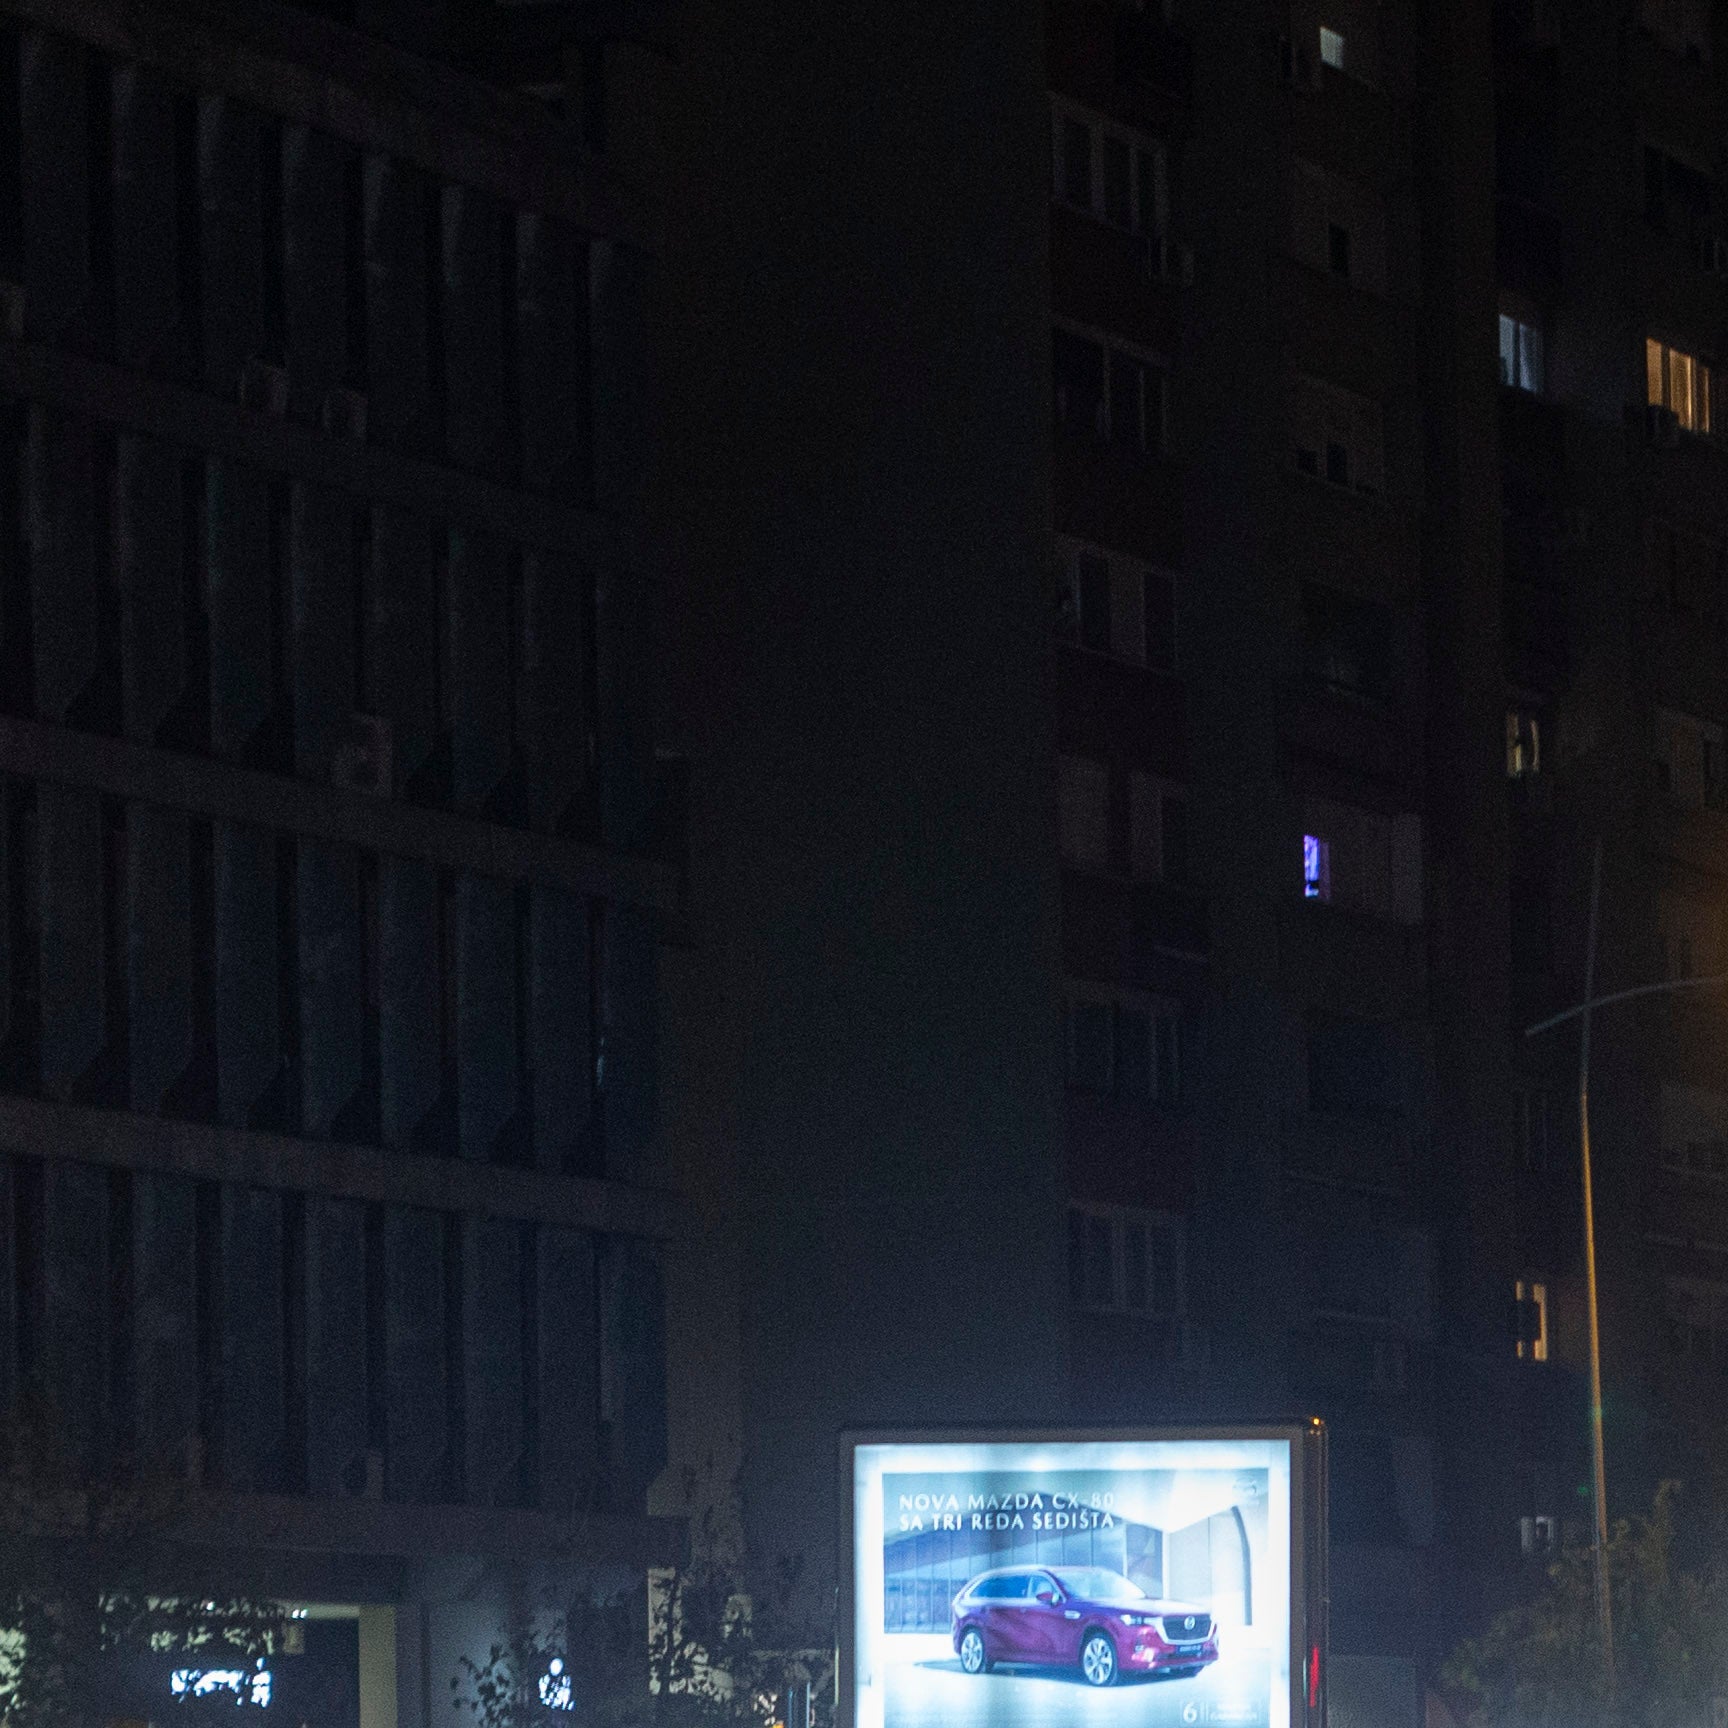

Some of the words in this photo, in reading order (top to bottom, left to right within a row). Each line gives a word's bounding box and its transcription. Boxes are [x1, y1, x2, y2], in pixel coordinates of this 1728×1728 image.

[900, 1493, 959, 1511] NOVA
[967, 1493, 1043, 1511] MAZDA
[1052, 1492, 1114, 1510] CX-80
[900, 1513, 923, 1531] SA
[932, 1513, 962, 1531] TRI
[972, 1512, 1024, 1531] REDA
[1032, 1509, 1115, 1530] SEDIŠTA
[1183, 1701, 1198, 1723] 6
